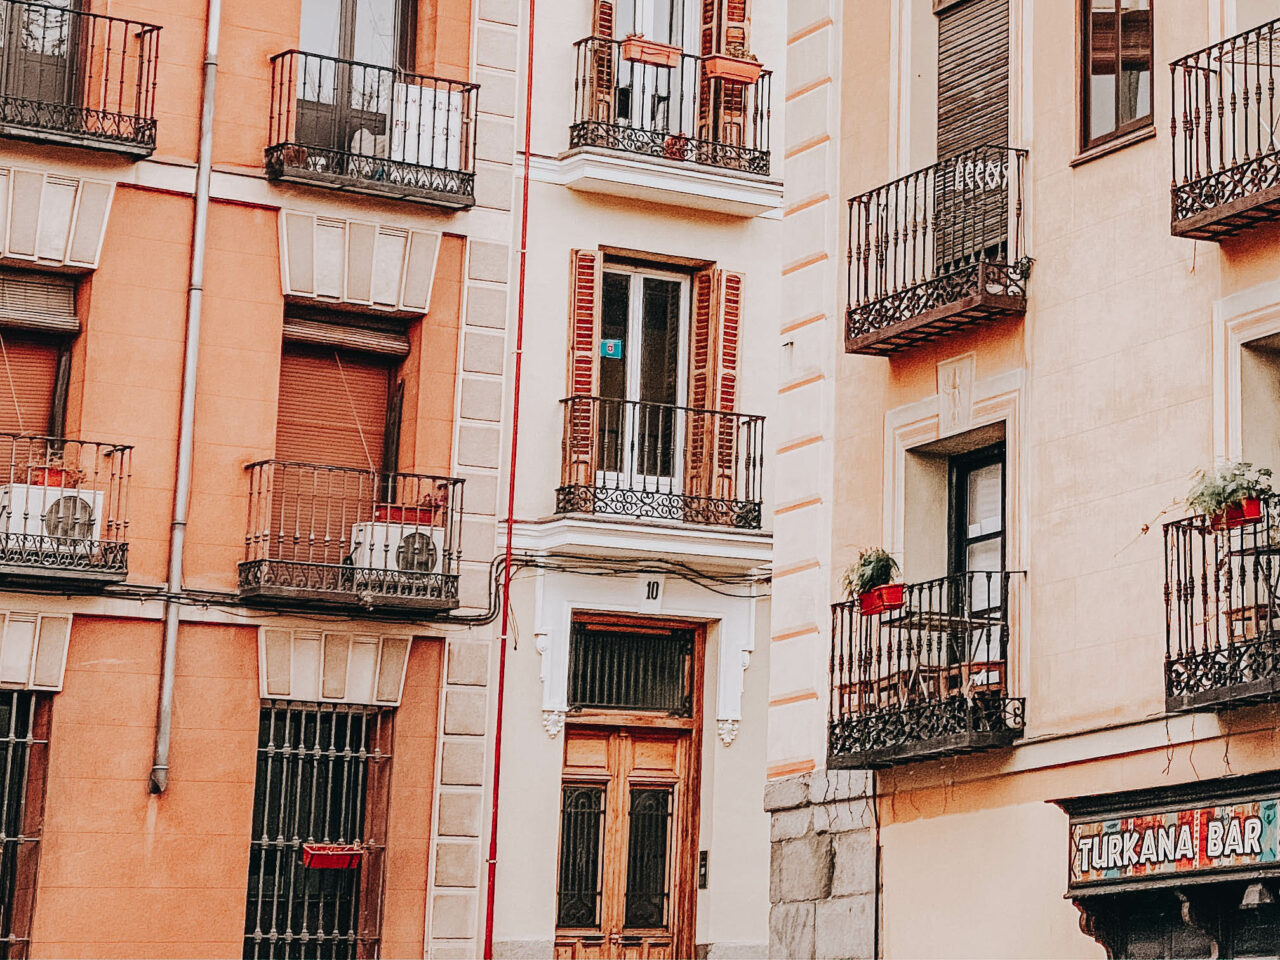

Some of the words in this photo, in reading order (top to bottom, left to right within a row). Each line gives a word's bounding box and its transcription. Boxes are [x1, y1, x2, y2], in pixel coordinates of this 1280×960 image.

[646, 581, 660, 600] 10
[1078, 824, 1194, 872] TURKANA
[1207, 817, 1263, 858] BAR
